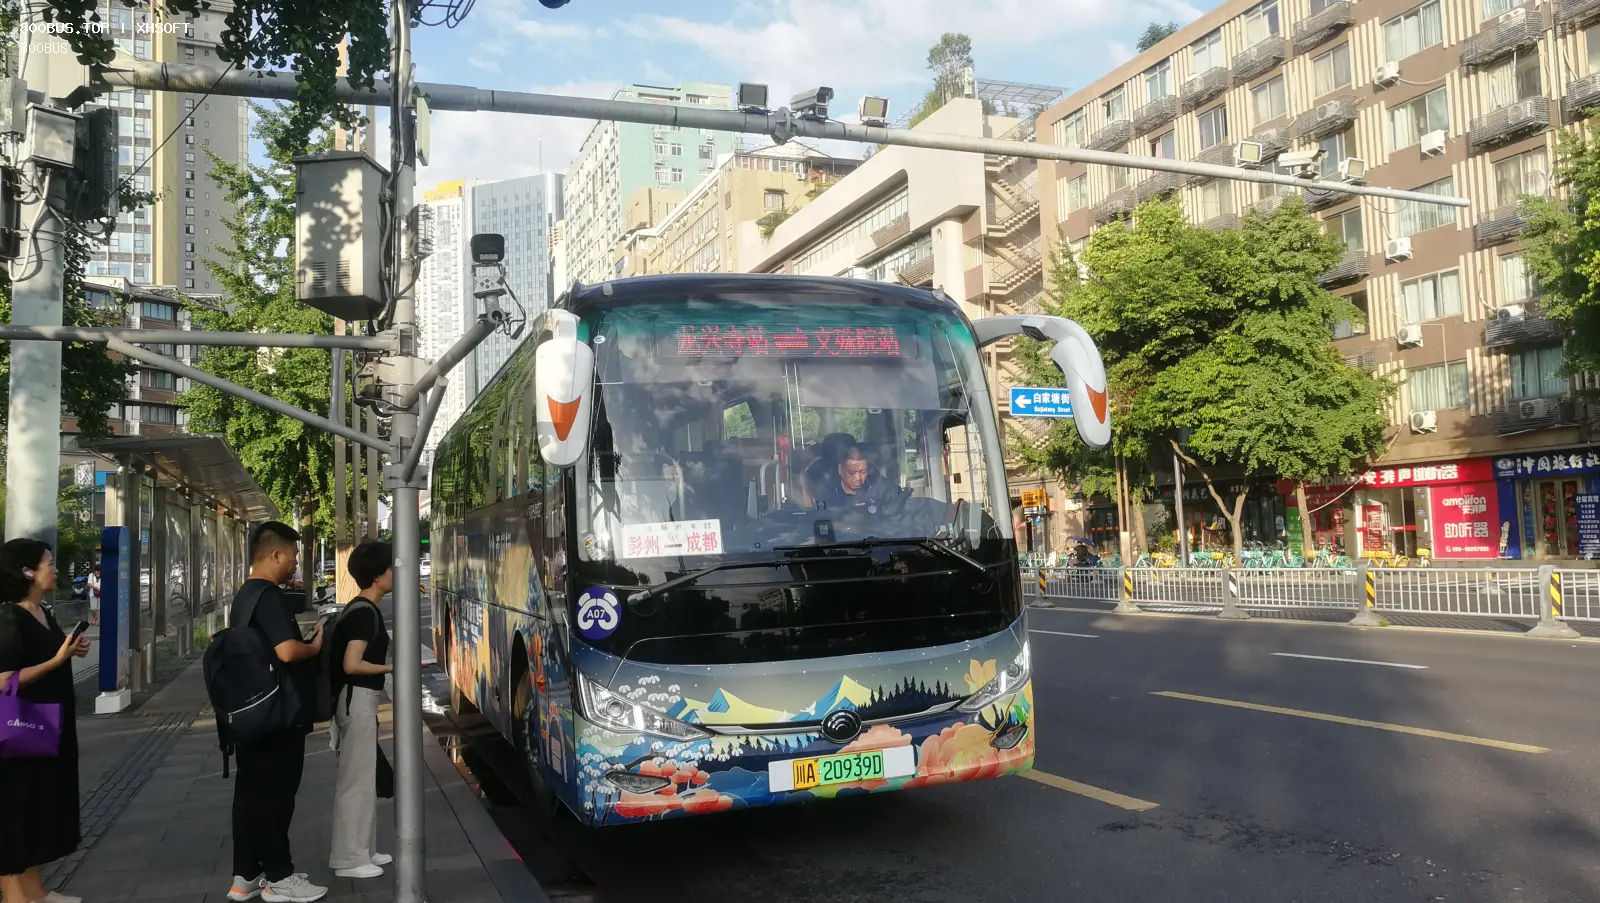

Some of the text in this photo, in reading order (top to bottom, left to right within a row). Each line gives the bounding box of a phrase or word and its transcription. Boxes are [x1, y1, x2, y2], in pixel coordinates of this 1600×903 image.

[1033, 392, 1071, 405] 白家塘街
[1442, 494, 1487, 509] amplifon
[1444, 521, 1489, 538] 助听器
[627, 531, 718, 557] 彭州 成都
[586, 609, 606, 619] A07
[7, 718, 36, 729] GANSO
[823, 754, 882, 781] 20939D
